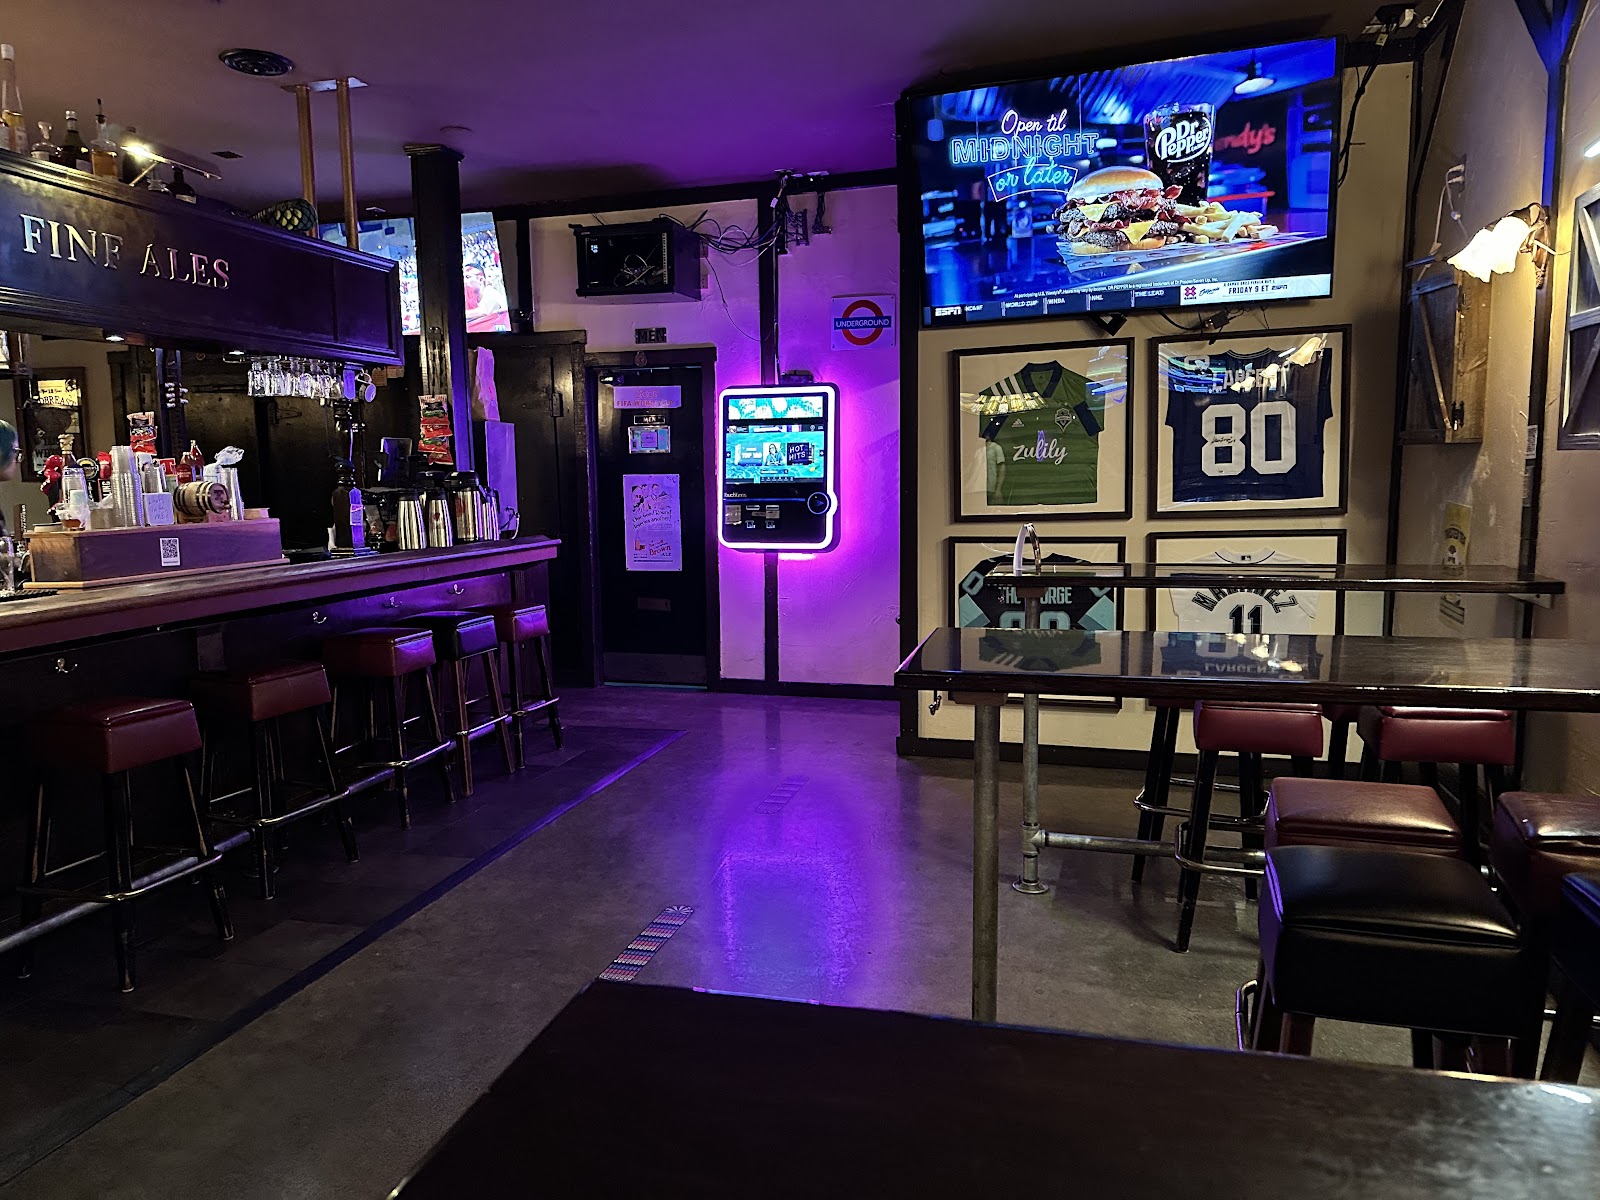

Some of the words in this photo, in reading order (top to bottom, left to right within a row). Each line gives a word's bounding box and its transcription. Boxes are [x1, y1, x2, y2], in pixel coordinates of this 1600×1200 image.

[1001, 109, 1043, 139] Open
[1046, 108, 1067, 132] til
[1176, 120, 1200, 141] Dr
[951, 132, 1100, 164] MIDNIGHT
[1159, 126, 1209, 160] Pepper
[995, 172, 1019, 191] or
[1023, 157, 1073, 185] later
[20, 213, 124, 270] FINE
[140, 243, 230, 290] ALES
[1228, 286, 1252, 294] FRIDAY
[1261, 284, 1269, 292] ET
[935, 306, 962, 317] ESPN
[835, 318, 890, 328] UNDERGROUND
[637, 329, 665, 342] MEN
[633, 399, 657, 407] WORLD
[789, 444, 804, 453] HOT
[1202, 401, 1297, 477] 80
[788, 451, 806, 461] HITS
[1012, 438, 1068, 465] zulily
[649, 545, 672, 556] Brown
[1229, 604, 1263, 634] 11
